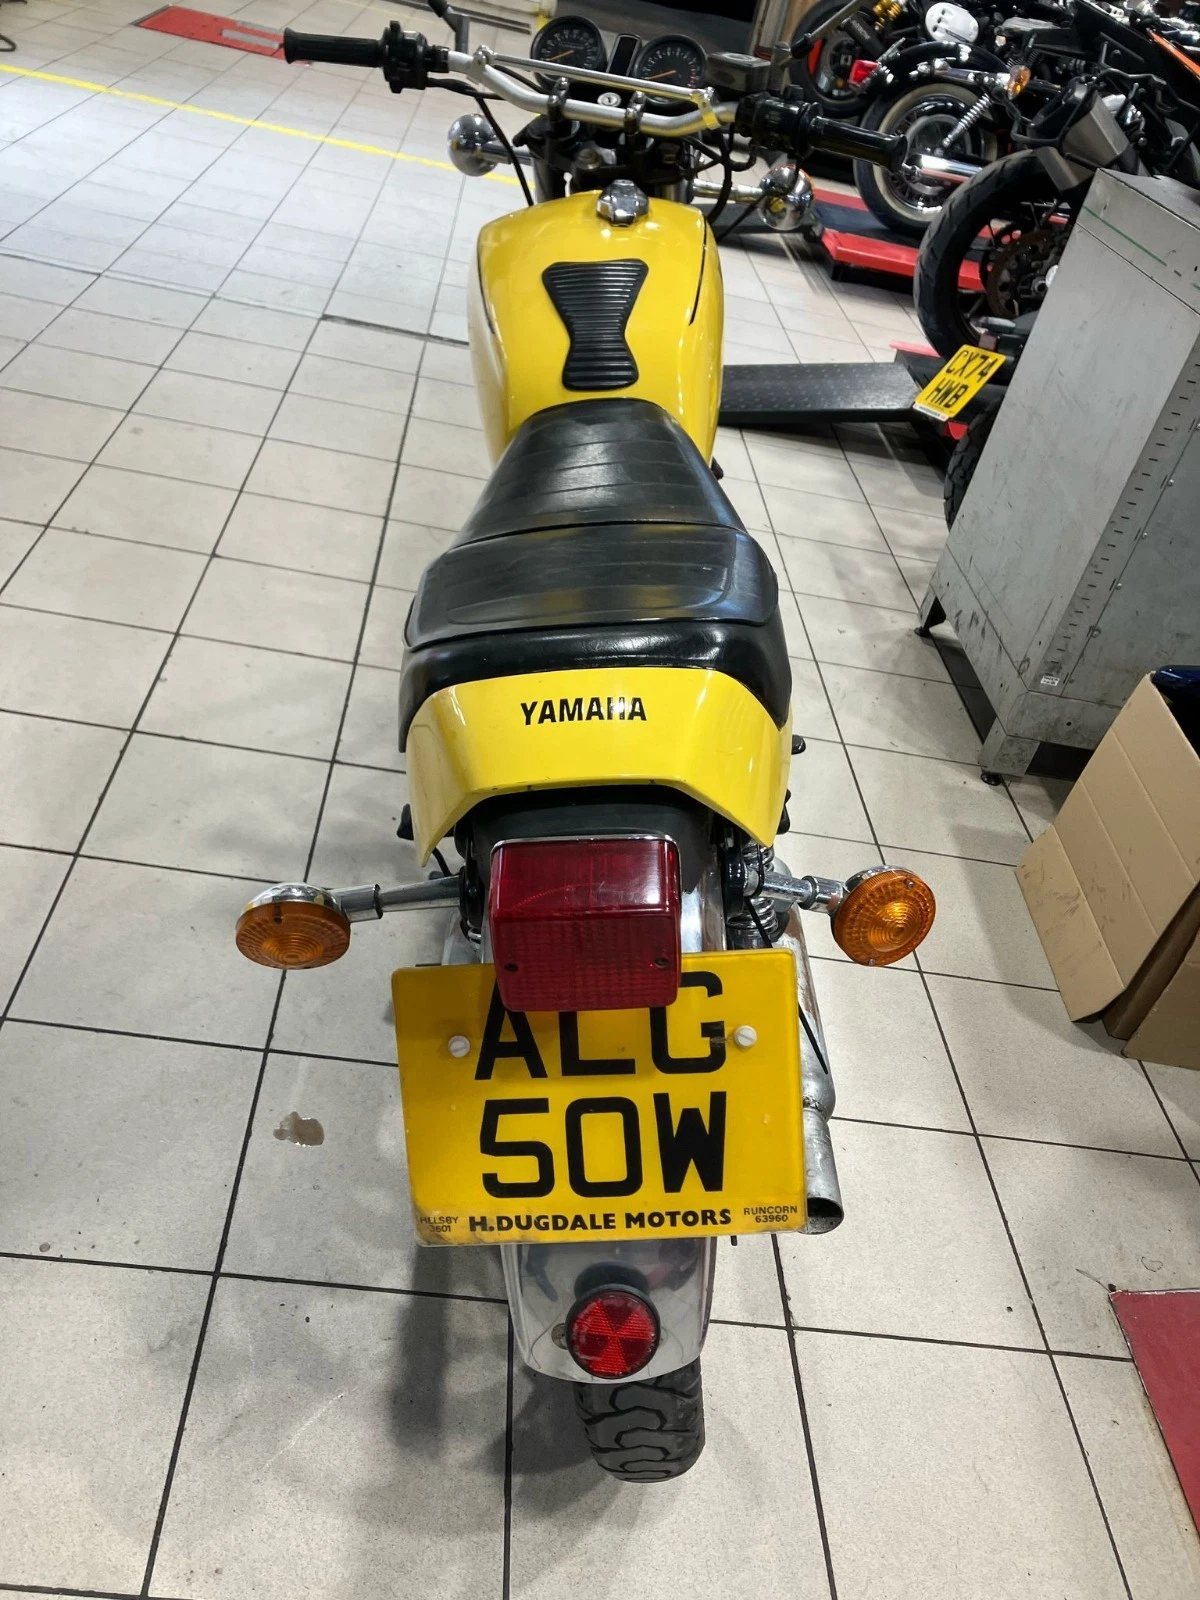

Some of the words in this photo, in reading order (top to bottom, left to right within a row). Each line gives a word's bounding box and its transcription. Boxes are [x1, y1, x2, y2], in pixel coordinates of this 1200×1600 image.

[945, 349, 999, 384] CX74
[520, 696, 647, 726] YAMAHA
[479, 1091, 727, 1199] 50W
[625, 1208, 732, 1229] MOTORS
[743, 1205, 798, 1215] RUNCORN
[754, 1214, 789, 1224] 63960
